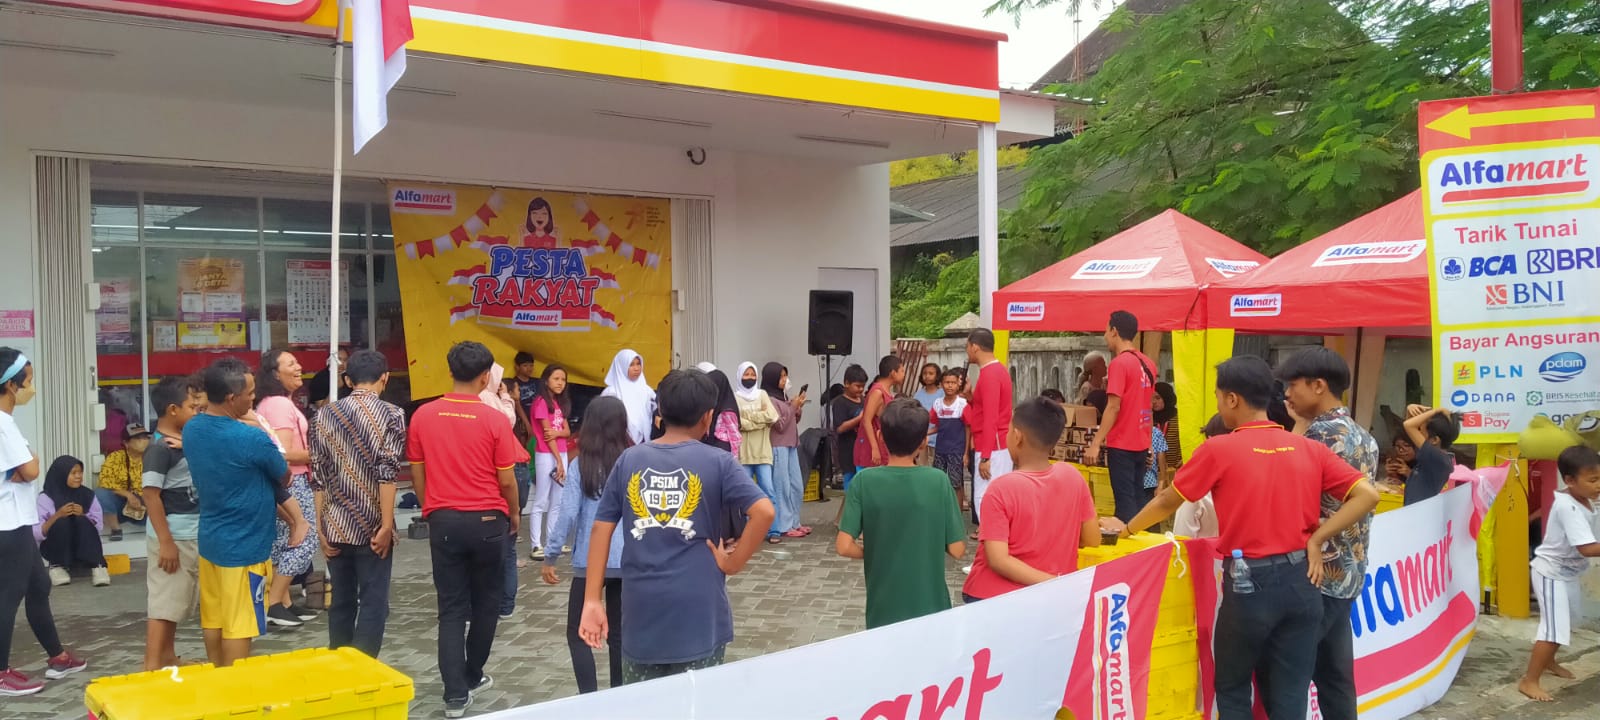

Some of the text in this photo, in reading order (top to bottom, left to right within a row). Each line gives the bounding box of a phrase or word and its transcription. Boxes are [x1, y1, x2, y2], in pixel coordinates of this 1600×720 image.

[1440, 153, 1588, 187] Alfamart
[395, 190, 453, 204] Alfamart
[1454, 219, 1578, 244] Tarik Tunai
[1328, 243, 1420, 257] Alfamart
[490, 246, 587, 277] PESTA
[1468, 254, 1518, 277] BCA
[1556, 246, 1600, 271] BRI
[472, 276, 600, 306] RAKYAT
[1512, 280, 1565, 304] BNI
[1009, 304, 1042, 312] Alfamart
[1234, 297, 1278, 307] Alfamart
[515, 312, 559, 322] Alfamart
[1450, 332, 1600, 352] Bayar Angsuran
[1545, 354, 1583, 369] pdam
[1479, 365, 1523, 379] PLN
[1471, 392, 1516, 403] DANA
[1484, 416, 1510, 429] Pay
[650, 475, 679, 489] PSIM
